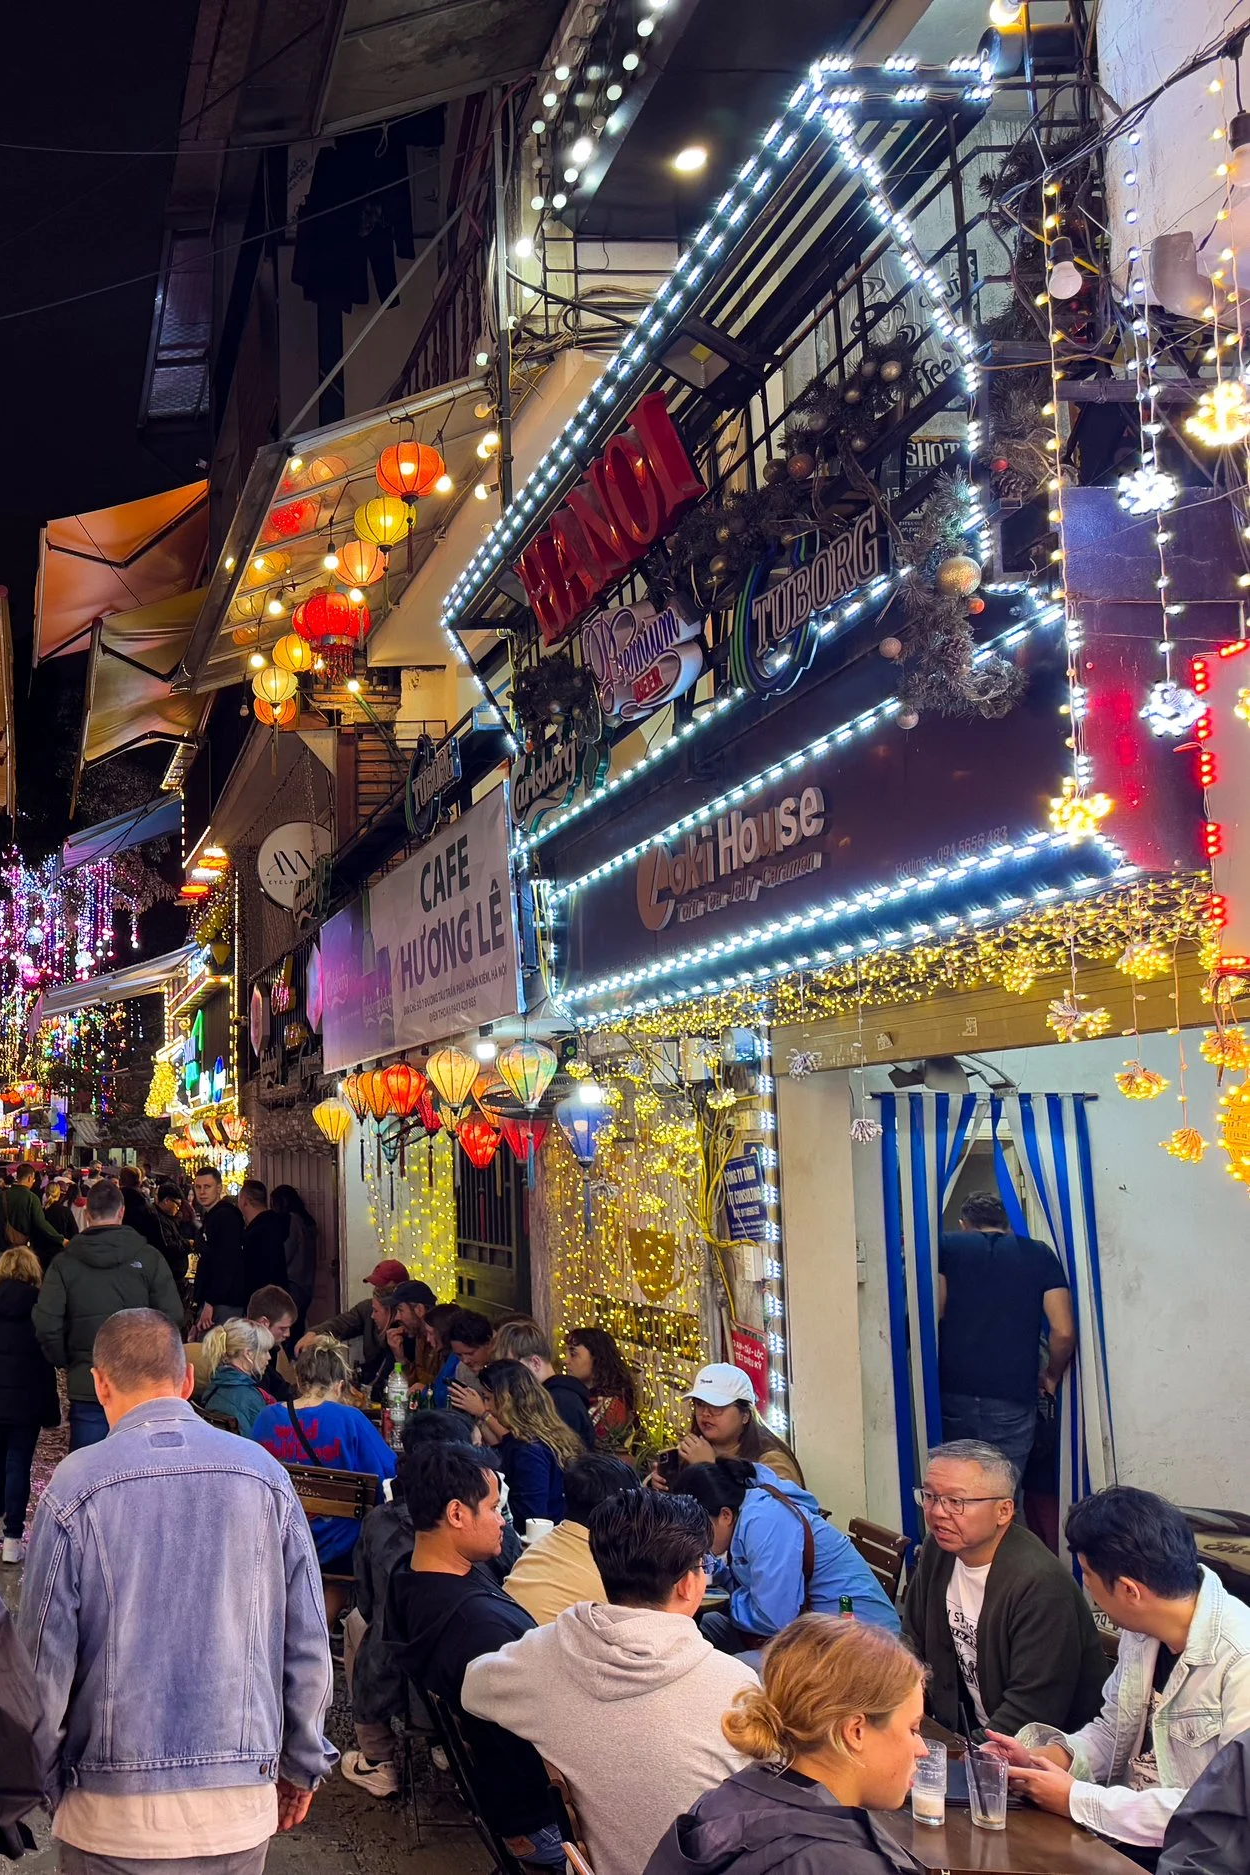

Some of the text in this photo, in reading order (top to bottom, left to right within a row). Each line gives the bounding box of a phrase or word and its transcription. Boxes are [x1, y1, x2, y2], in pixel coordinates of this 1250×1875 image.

[512, 390, 708, 648] HANOI
[752, 505, 879, 657] TUBORG
[582, 606, 680, 716] Premium
[412, 745, 455, 816] TUBORG
[512, 740, 578, 825] Carlsberg
[420, 834, 470, 913] CAFE
[718, 787, 825, 876] House
[401, 878, 504, 992] HƯƠNG LÊ
